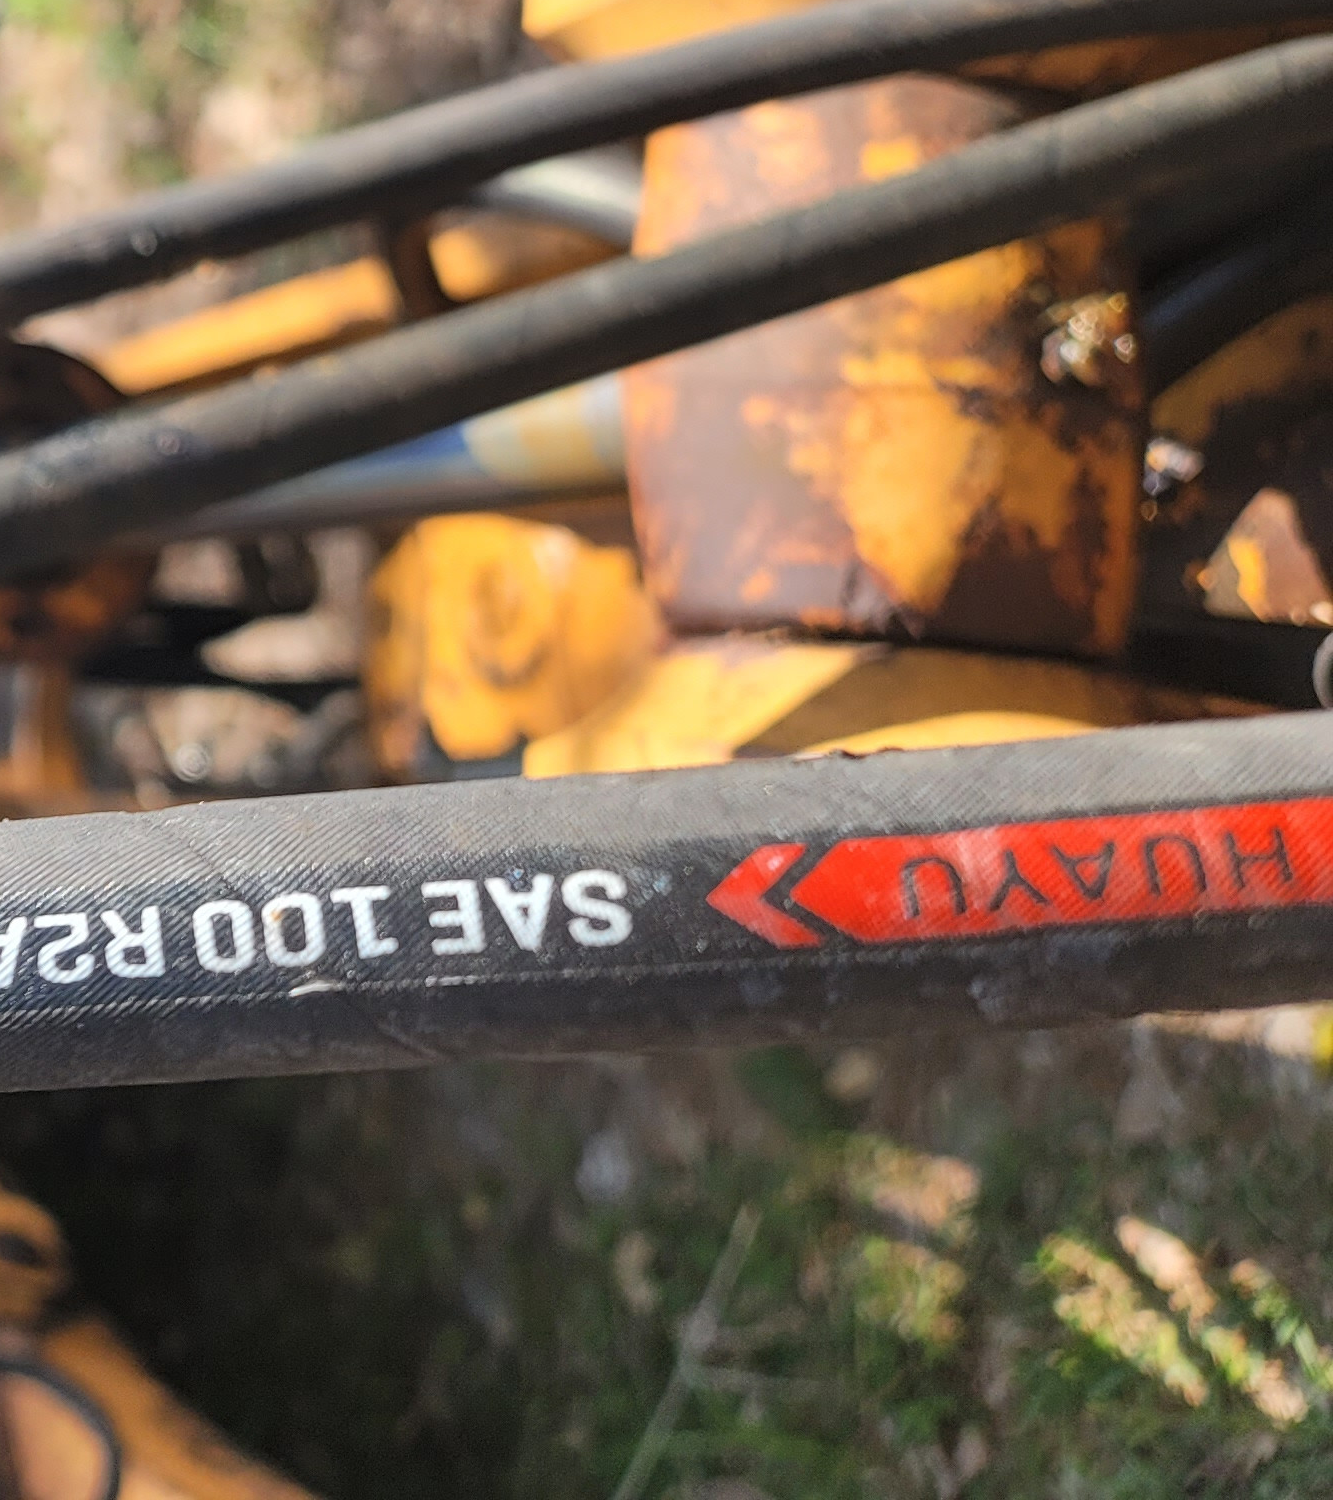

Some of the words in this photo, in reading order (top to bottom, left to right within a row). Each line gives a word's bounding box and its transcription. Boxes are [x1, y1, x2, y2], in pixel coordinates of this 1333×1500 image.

[421, 868, 633, 956] SAE
[900, 826, 1294, 920] HUAYU
[190, 884, 400, 974] 100
